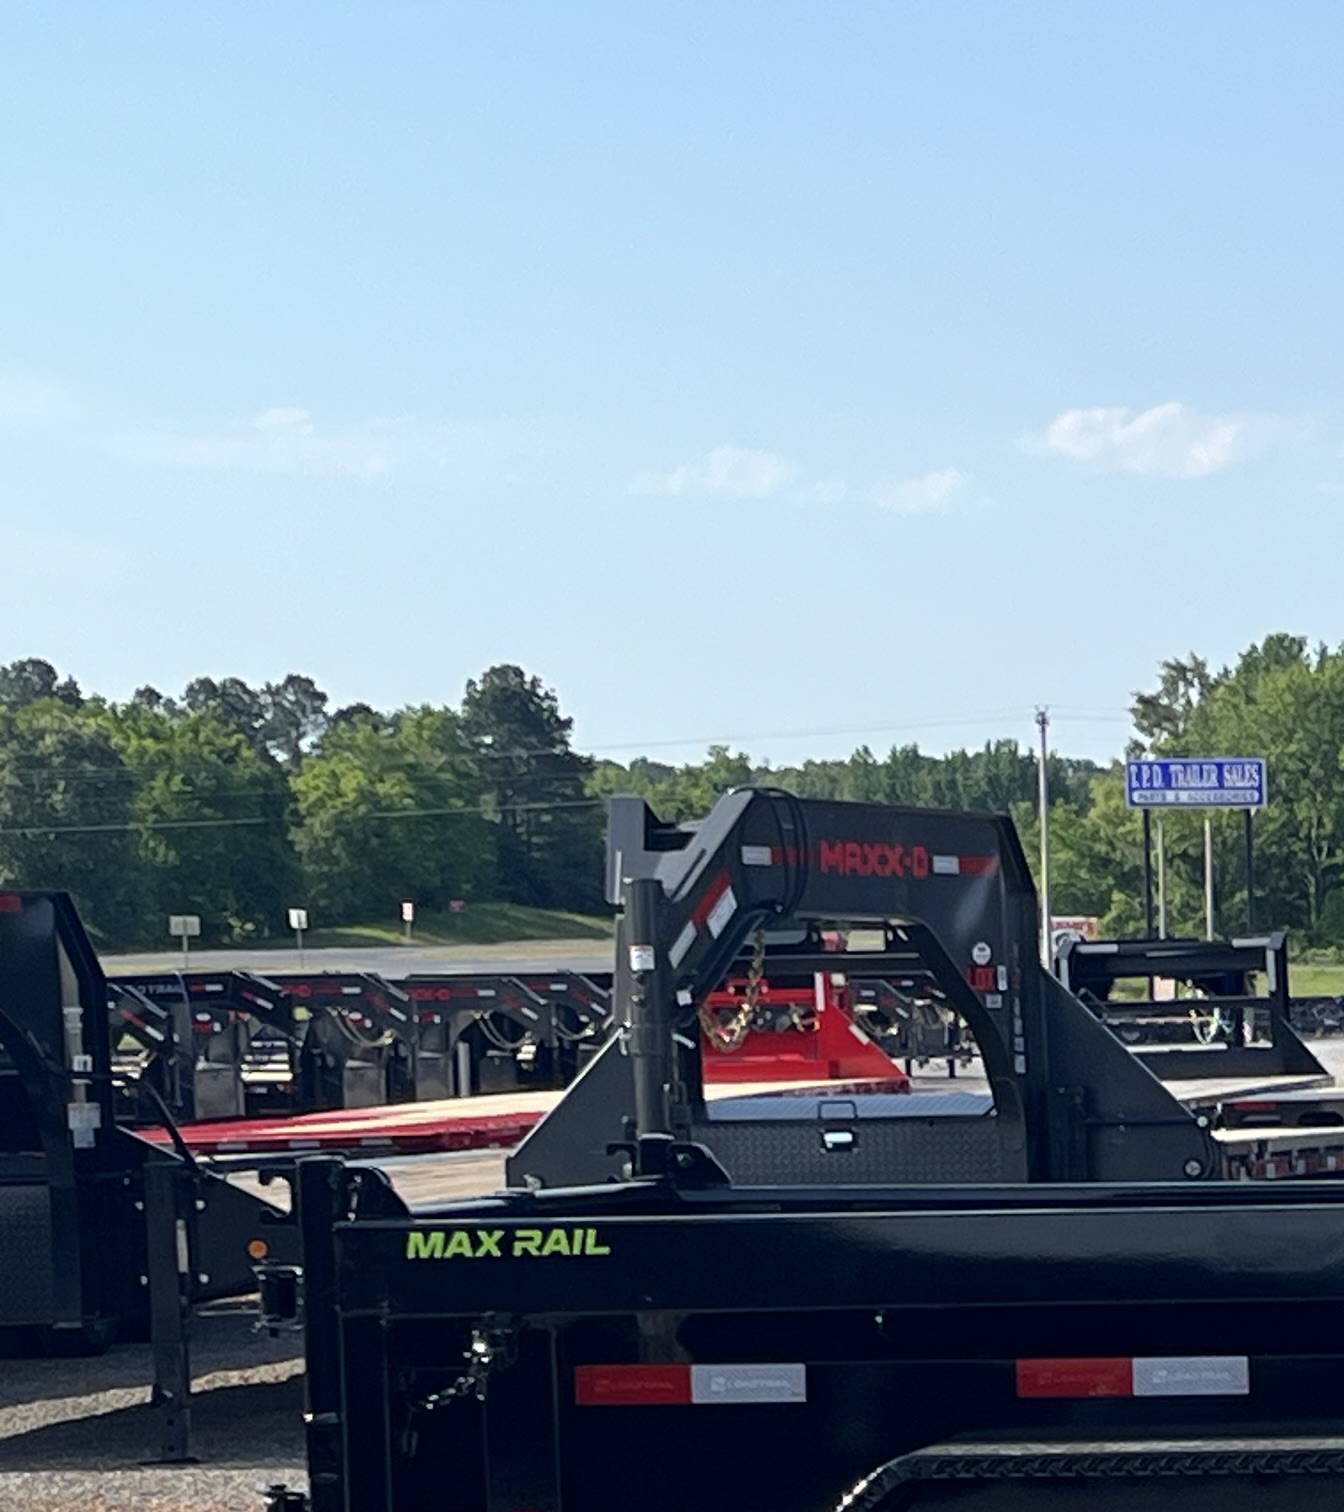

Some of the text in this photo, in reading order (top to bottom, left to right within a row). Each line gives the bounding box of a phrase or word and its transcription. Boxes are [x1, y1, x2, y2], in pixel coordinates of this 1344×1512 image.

[1169, 764, 1219, 788] TRAILER
[1223, 764, 1260, 788] SALES
[820, 839, 930, 881] MAXX-D
[406, 1227, 611, 1260] MAX RAIL
